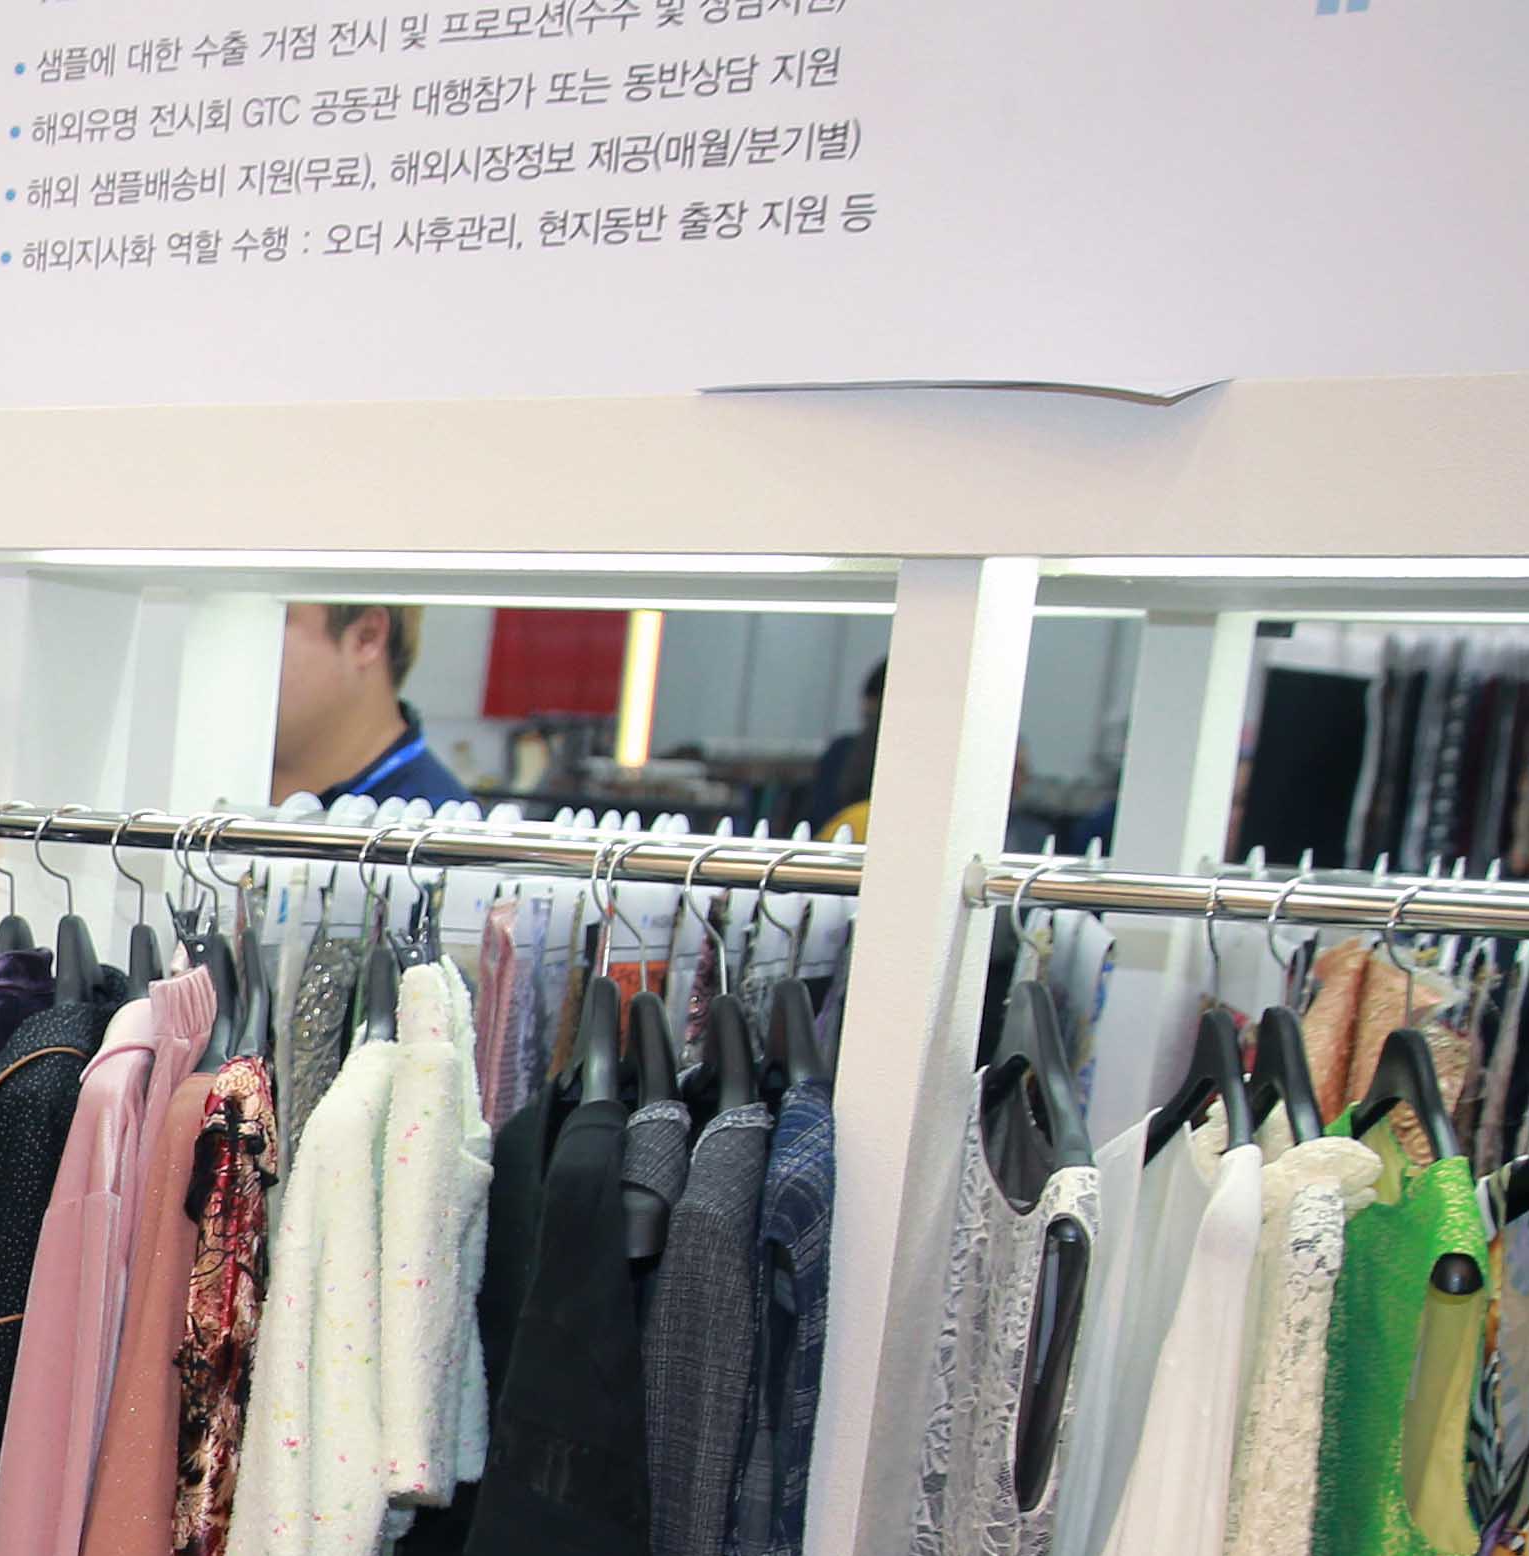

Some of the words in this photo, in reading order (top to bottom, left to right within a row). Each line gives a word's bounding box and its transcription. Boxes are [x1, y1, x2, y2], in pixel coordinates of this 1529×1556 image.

[36, 42, 117, 84] 샘플에
[127, 37, 183, 74] 대한
[191, 30, 248, 69] 수출
[259, 23, 317, 62] 거점
[328, 16, 388, 57] 전시
[399, 13, 429, 51] 및
[31, 105, 138, 146] 해외유명
[149, 97, 232, 138] 전시회
[242, 94, 301, 128] GTC
[311, 83, 401, 127] 공동관
[413, 71, 536, 117] 대행참가
[546, 67, 612, 106] 또는
[623, 53, 759, 102] 동반상담
[770, 46, 841, 88] 지원
[26, 172, 79, 208] 해외
[90, 163, 226, 206] 샘플배송비
[237, 152, 377, 196] 지원(무료),
[391, 140, 576, 186] 해외시장정보
[587, 118, 862, 176] 제공(매월/분기별)
[21, 232, 156, 273] 해외지사화
[166, 228, 223, 266] 역할
[231, 224, 291, 263] 수행
[322, 219, 384, 256] 오더
[393, 211, 524, 253] 사후관리,
[540, 204, 668, 248] 현지동반
[678, 199, 749, 241] 출장
[758, 194, 829, 235] 지원
[840, 193, 877, 233] 등
